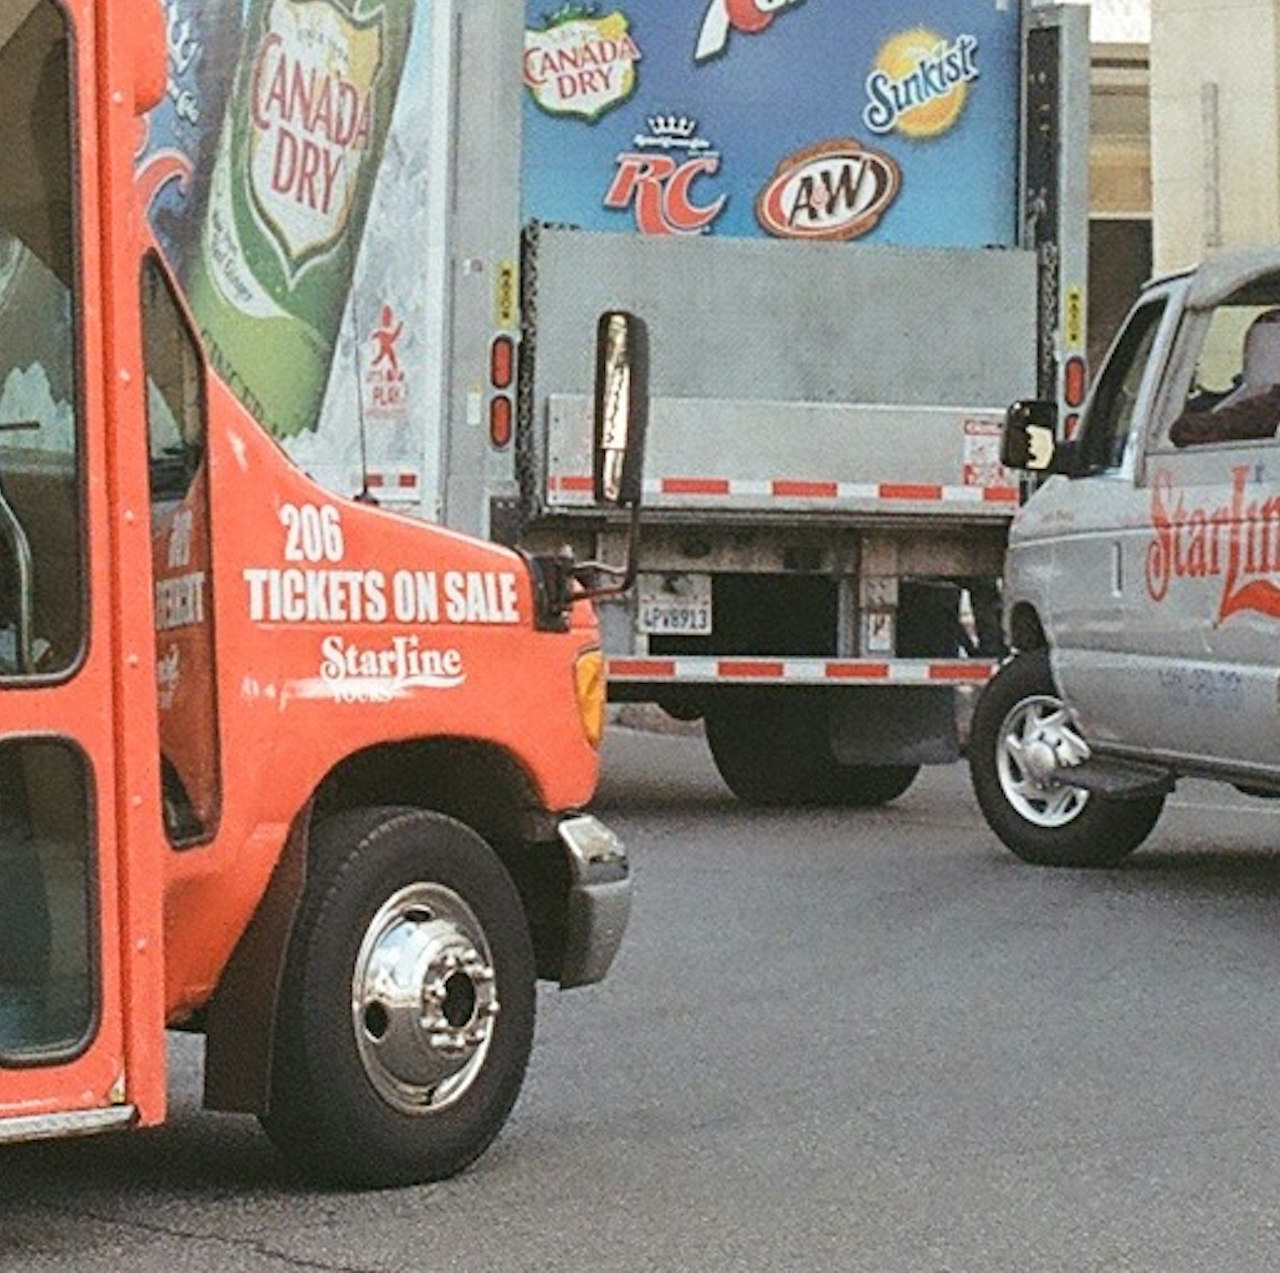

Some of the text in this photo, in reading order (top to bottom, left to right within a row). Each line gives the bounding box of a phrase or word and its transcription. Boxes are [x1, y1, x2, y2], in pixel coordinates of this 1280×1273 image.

[250, 31, 372, 150] CANADA
[522, 36, 639, 86] CANADA
[556, 65, 613, 100] DRY
[865, 35, 977, 131] Sunkist
[271, 126, 345, 215] DRY
[603, 152, 728, 236] RC
[280, 503, 344, 563] 206
[243, 568, 388, 623] TICKETS
[393, 569, 440, 624] ON
[444, 570, 521, 624] SALE
